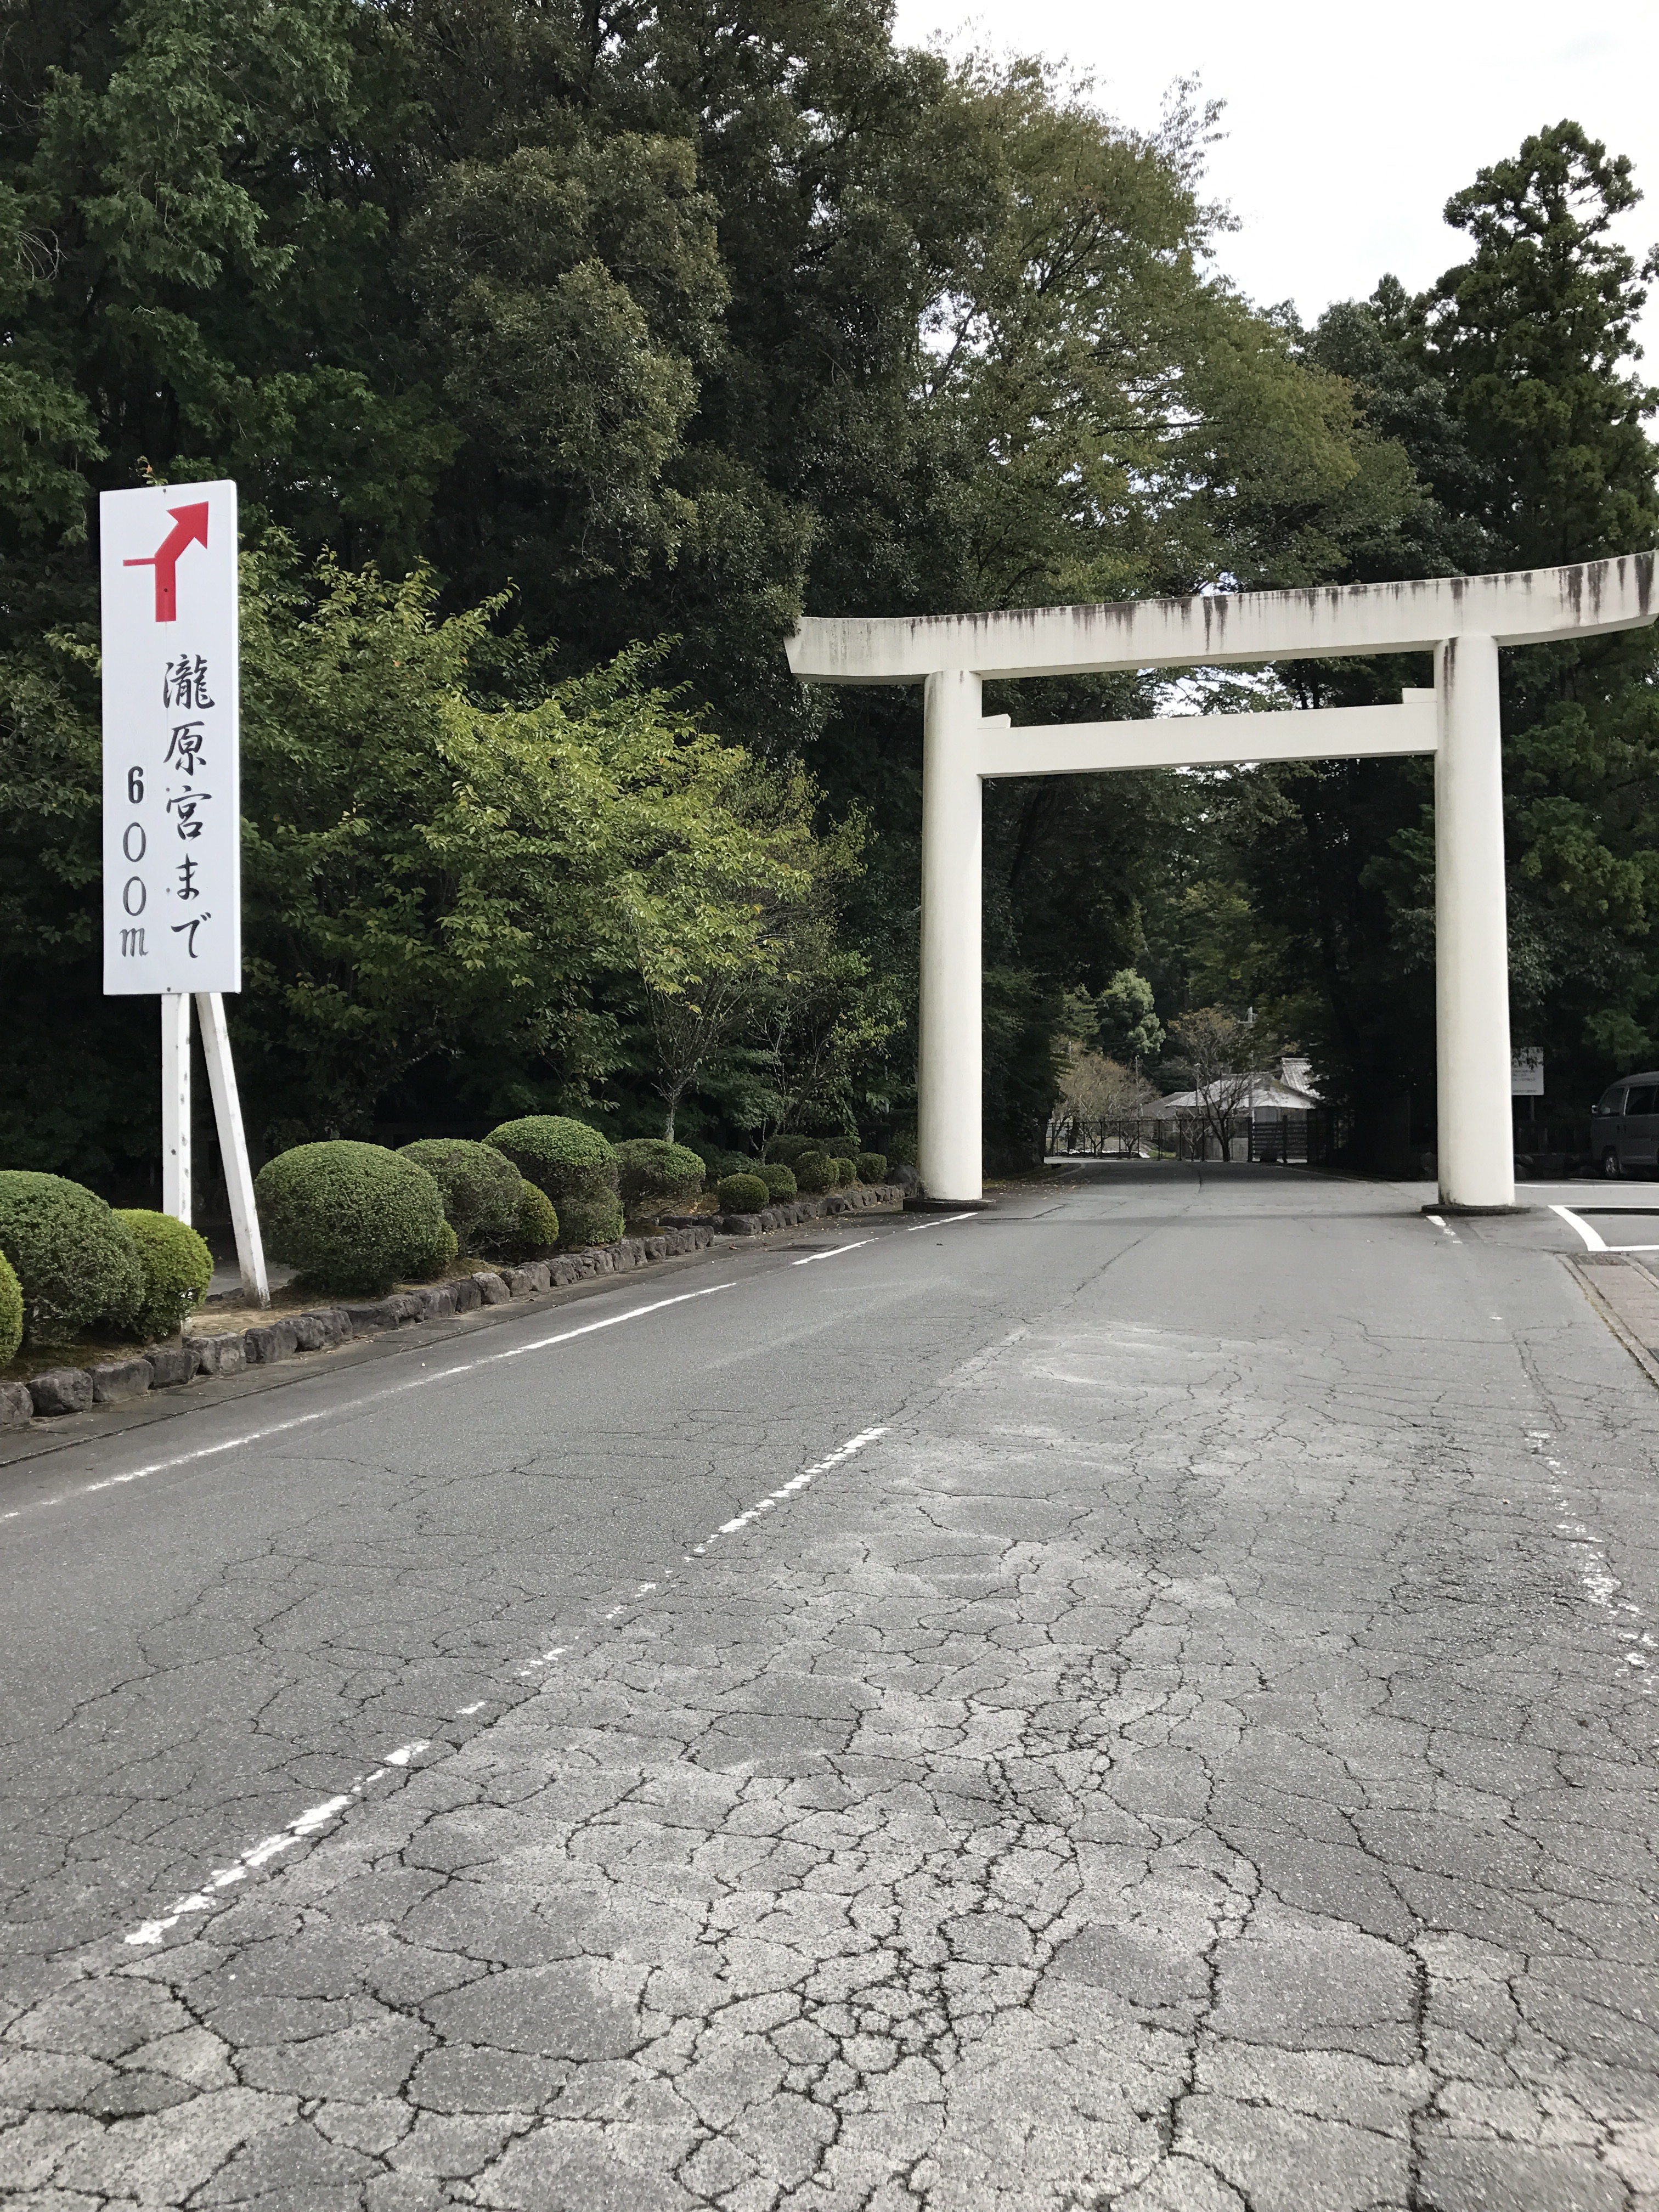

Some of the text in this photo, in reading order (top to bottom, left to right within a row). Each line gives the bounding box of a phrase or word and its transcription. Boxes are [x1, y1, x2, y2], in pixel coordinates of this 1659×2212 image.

[120, 766, 149, 957] 600m
[163, 653, 215, 958] 瀧原宮まで
